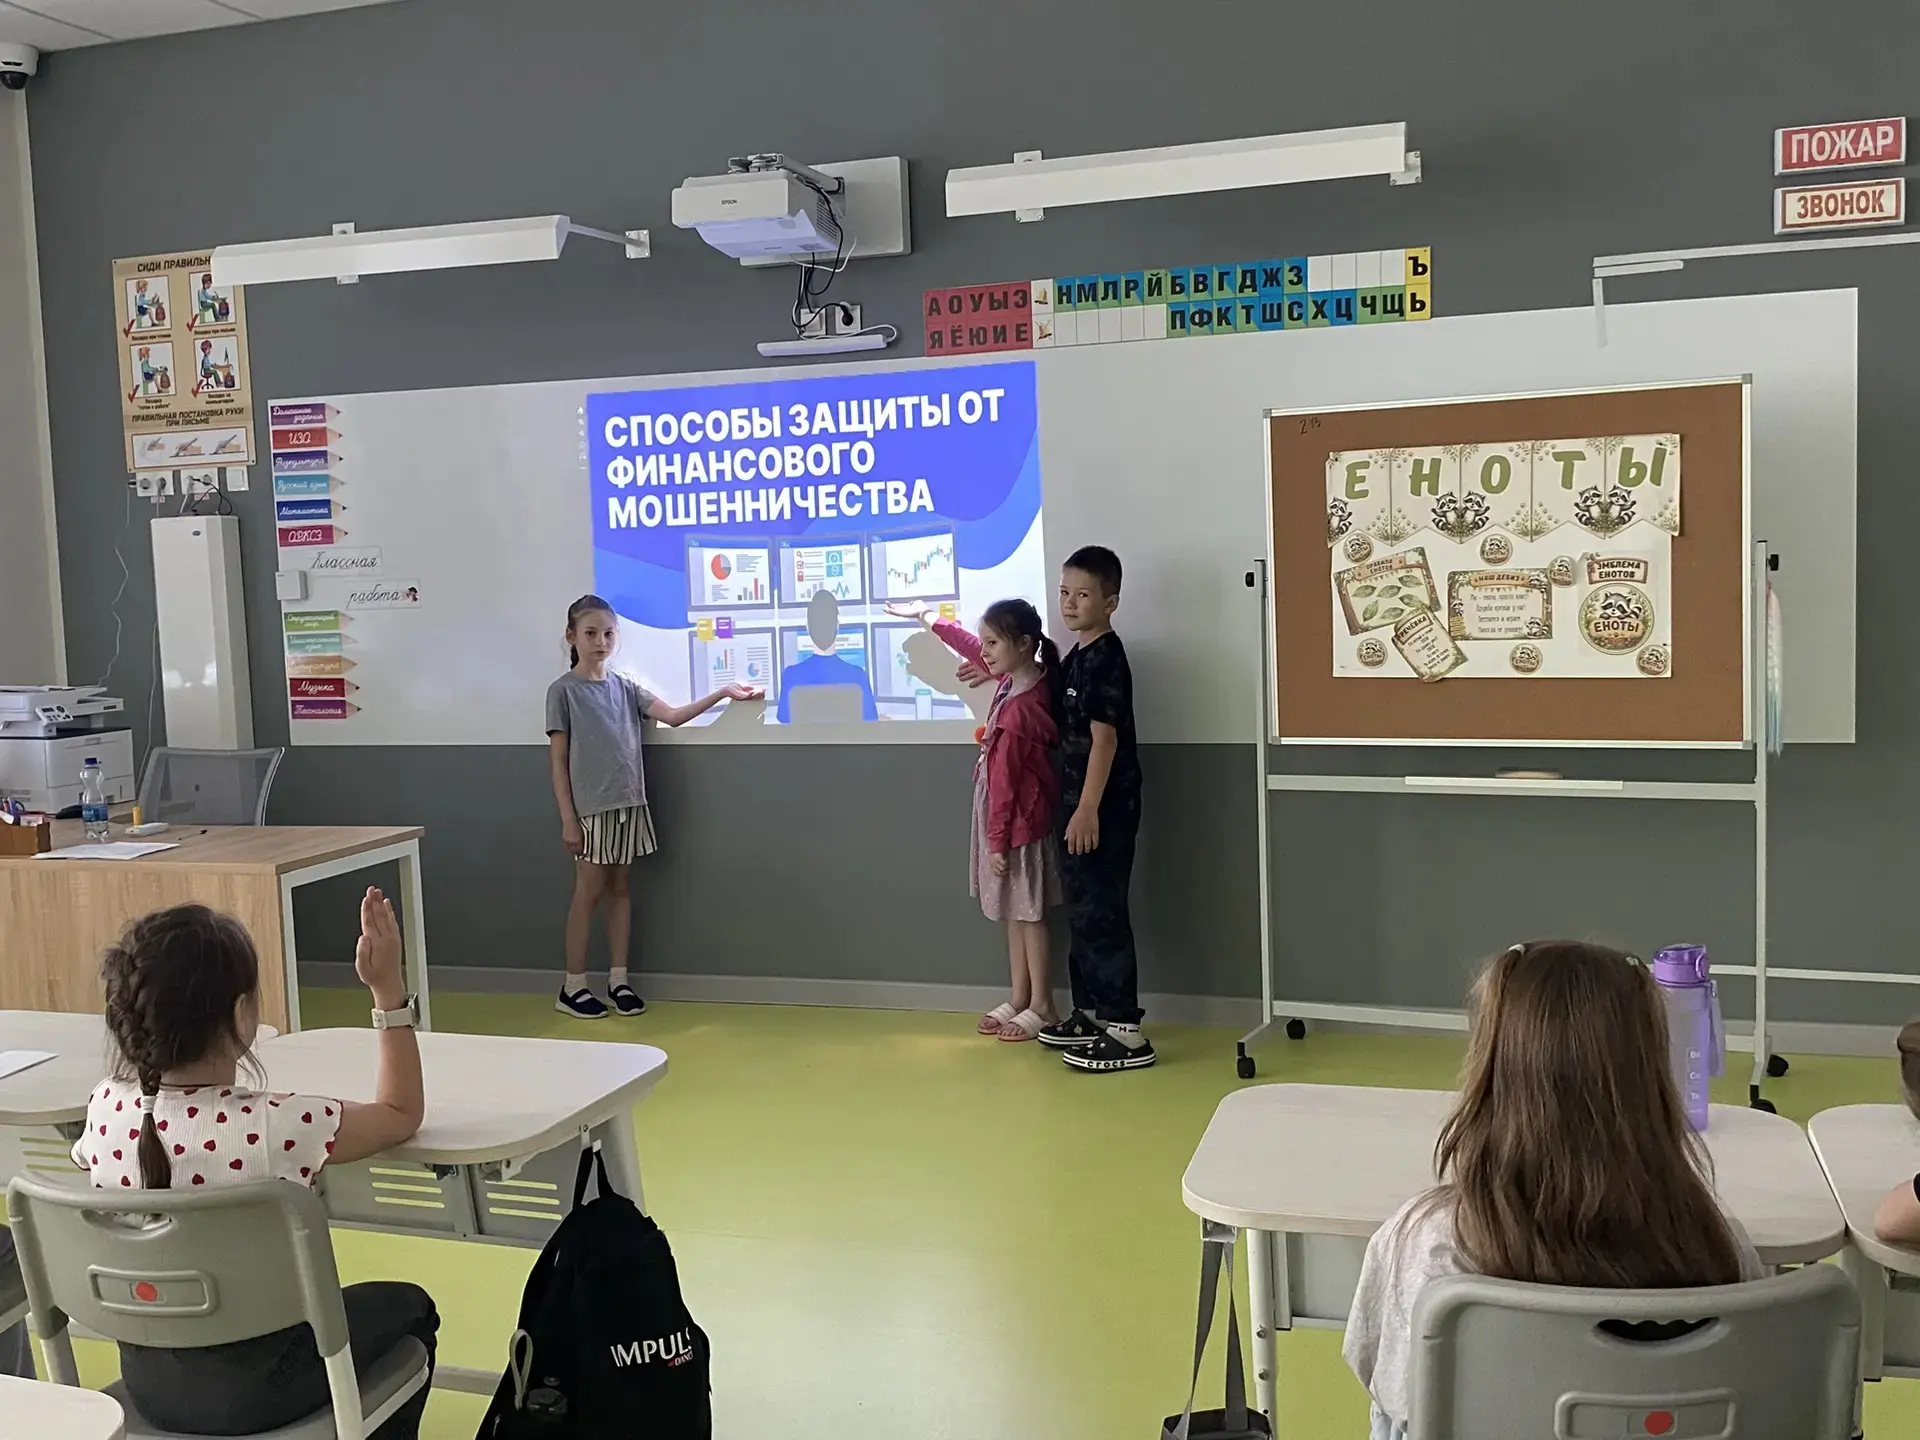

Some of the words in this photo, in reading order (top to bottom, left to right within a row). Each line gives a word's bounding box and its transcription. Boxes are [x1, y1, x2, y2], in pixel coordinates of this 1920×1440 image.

[1791, 126, 1894, 163] ПОЖАР
[1797, 189, 1884, 219] ЗВОНОК
[137, 261, 161, 272] СИДИ
[164, 256, 211, 271] ПРАВИЛЬН
[132, 412, 177, 422] ПРАВИЛЬНАЯ
[179, 409, 223, 419] ПОСТАНОВКА
[225, 408, 244, 416] РУКИ
[182, 418, 210, 426] ПИСЬМЕ
[604, 406, 781, 448] СПОСОБЫ
[788, 393, 951, 438] ЗАЩИТЫ
[958, 388, 1005, 424] ОТ
[288, 432, 311, 445] ИЗО
[606, 440, 875, 488] ФИНАНСОВОГО
[1344, 446, 1668, 500] ЕНОТЫ
[607, 478, 935, 529] МОШЕННИЧЕСТВА
[311, 551, 378, 569] Классная
[1597, 561, 1641, 570] ЭМБЛЕМА
[1599, 570, 1635, 579] ЕНОТОВ
[346, 584, 401, 609] работа
[1593, 620, 1639, 632] ЕНОТЫ
[298, 681, 335, 695] Музыка
[1087, 1060, 1126, 1068] crocs
